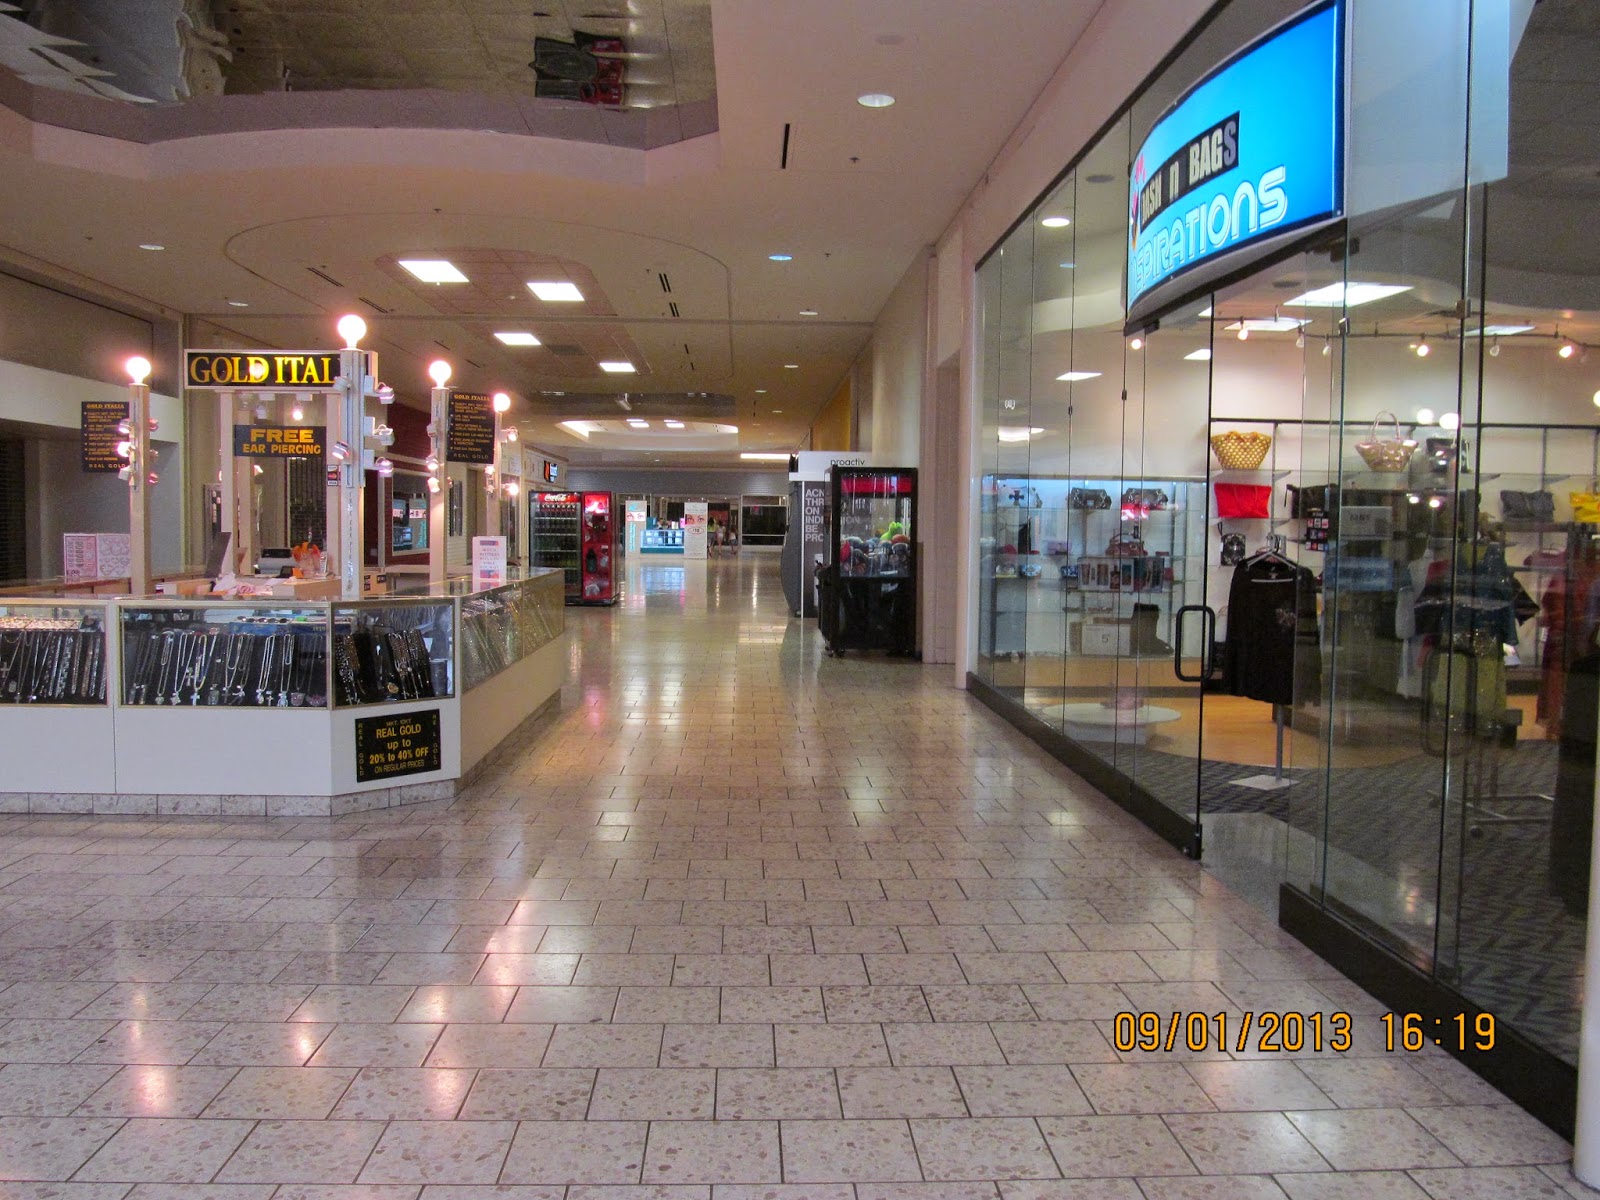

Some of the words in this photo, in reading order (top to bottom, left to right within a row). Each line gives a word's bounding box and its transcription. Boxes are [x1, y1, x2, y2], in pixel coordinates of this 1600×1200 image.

[1189, 120, 1237, 186] BAGS
[190, 356, 270, 383] GOLD
[274, 356, 338, 384] ITAL
[250, 429, 314, 443] FREE
[242, 443, 269, 454] EAR
[271, 444, 321, 455] PIERCING
[830, 457, 865, 466] proactiv
[805, 488, 824, 498] ACN
[805, 498, 824, 506] THR
[805, 506, 820, 515] ON
[805, 515, 823, 525] INDI
[805, 524, 819, 533] BE
[376, 727, 397, 739] REAL
[400, 723, 421, 736] GOLD
[387, 741, 398, 751] up
[402, 738, 411, 748] to
[369, 753, 385, 765] 20%
[388, 752, 395, 762] to
[397, 749, 413, 760] 40%
[415, 747, 429, 757] OFF
[374, 765, 383, 774] ON
[383, 762, 407, 772] REGULAR
[407, 759, 425, 769] PRICES
